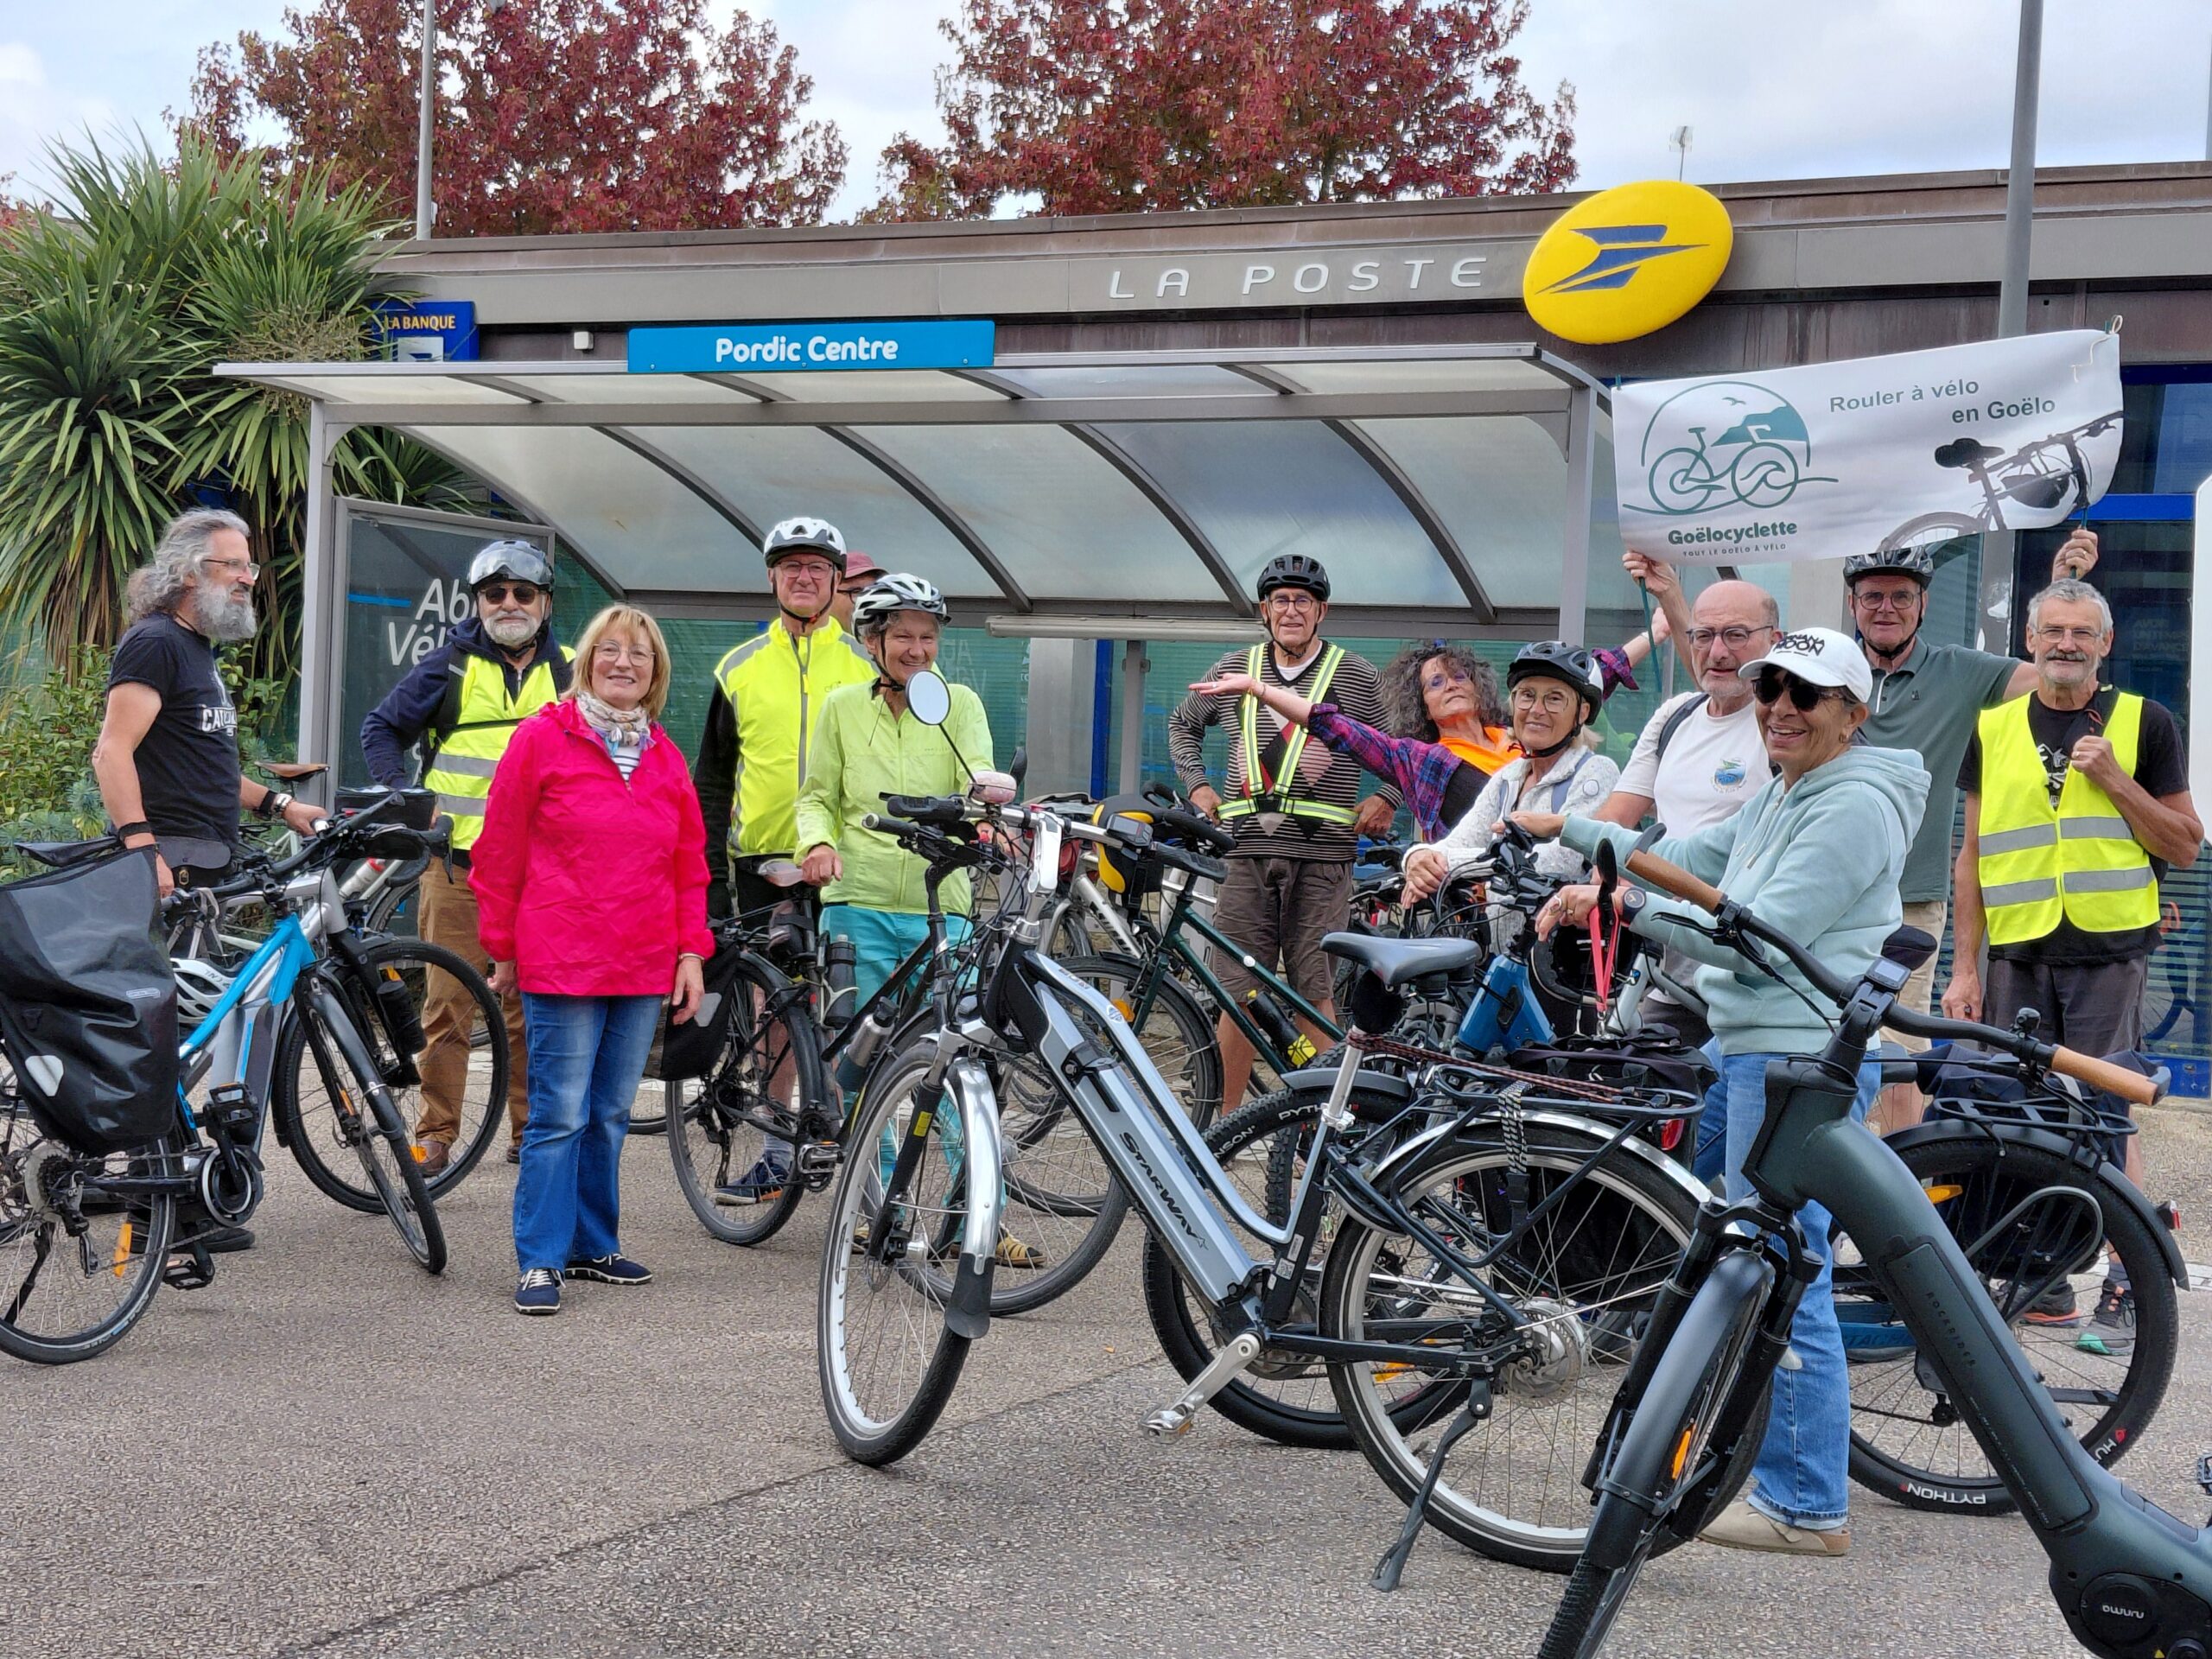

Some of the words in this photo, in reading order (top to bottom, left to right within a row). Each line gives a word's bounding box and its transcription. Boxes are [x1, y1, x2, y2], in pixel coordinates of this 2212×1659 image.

[1109, 268, 1191, 299] LA
[1242, 257, 1487, 296] POSTE
[403, 315, 456, 331] BANQUE
[715, 335, 802, 363] Pordic
[808, 335, 899, 362] Centre
[1830, 391, 1904, 412] Rouler
[1911, 385, 1924, 401] à
[1931, 379, 1980, 398] vélo
[1952, 408, 1980, 423] en
[1987, 397, 2056, 419] Goëlo
[1668, 521, 1798, 544] Goëlocyclette
[415, 578, 477, 625] Ab
[1906, 1482, 1986, 1504] PYTHON
